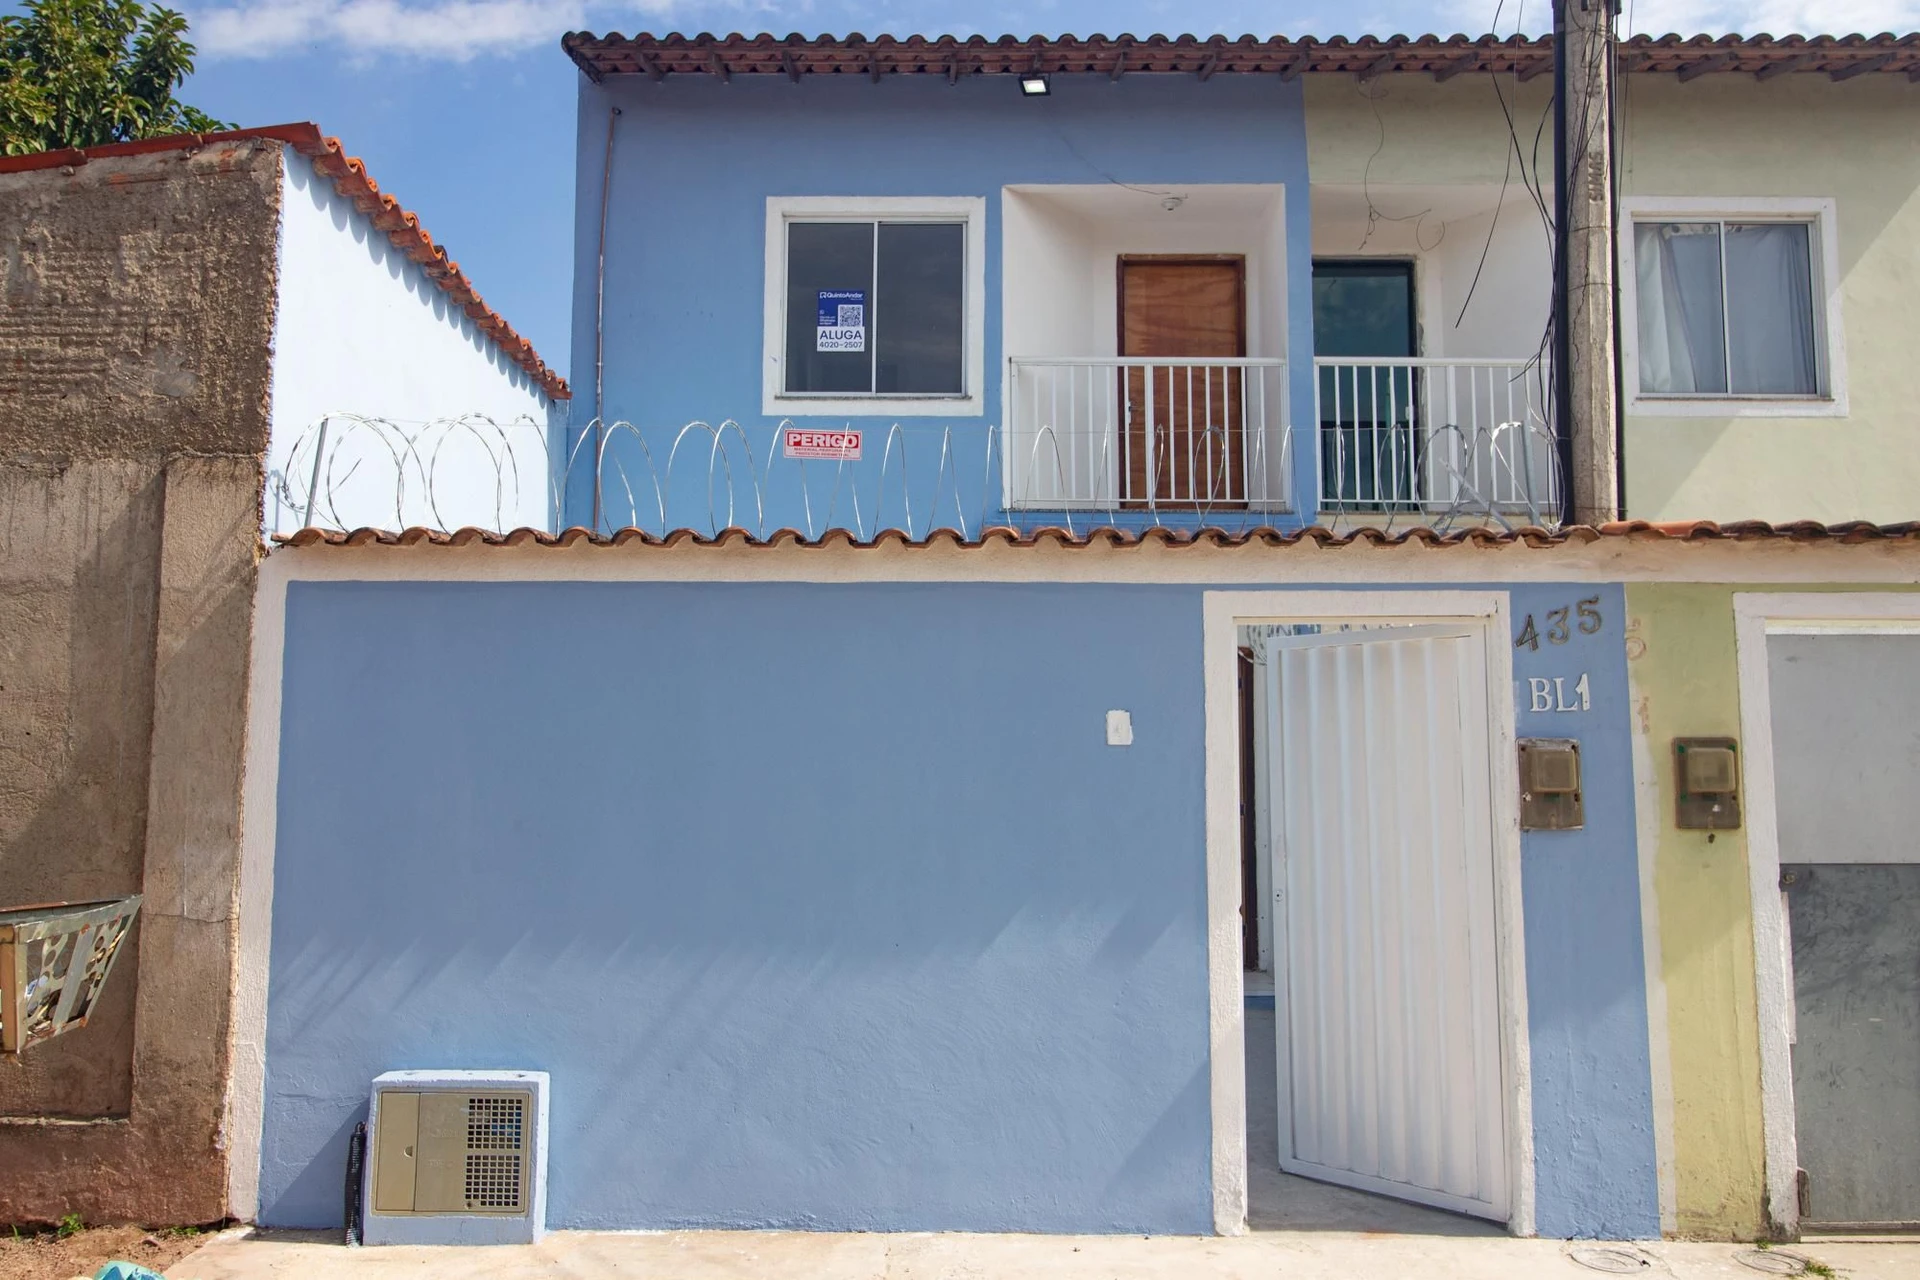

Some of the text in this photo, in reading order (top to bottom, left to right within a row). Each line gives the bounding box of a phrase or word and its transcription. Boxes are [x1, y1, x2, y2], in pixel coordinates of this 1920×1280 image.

[820, 330, 862, 340] ALUGA
[788, 433, 858, 448] PERIGO
[1515, 594, 1602, 651] 435
[1528, 672, 1590, 712] BL1
